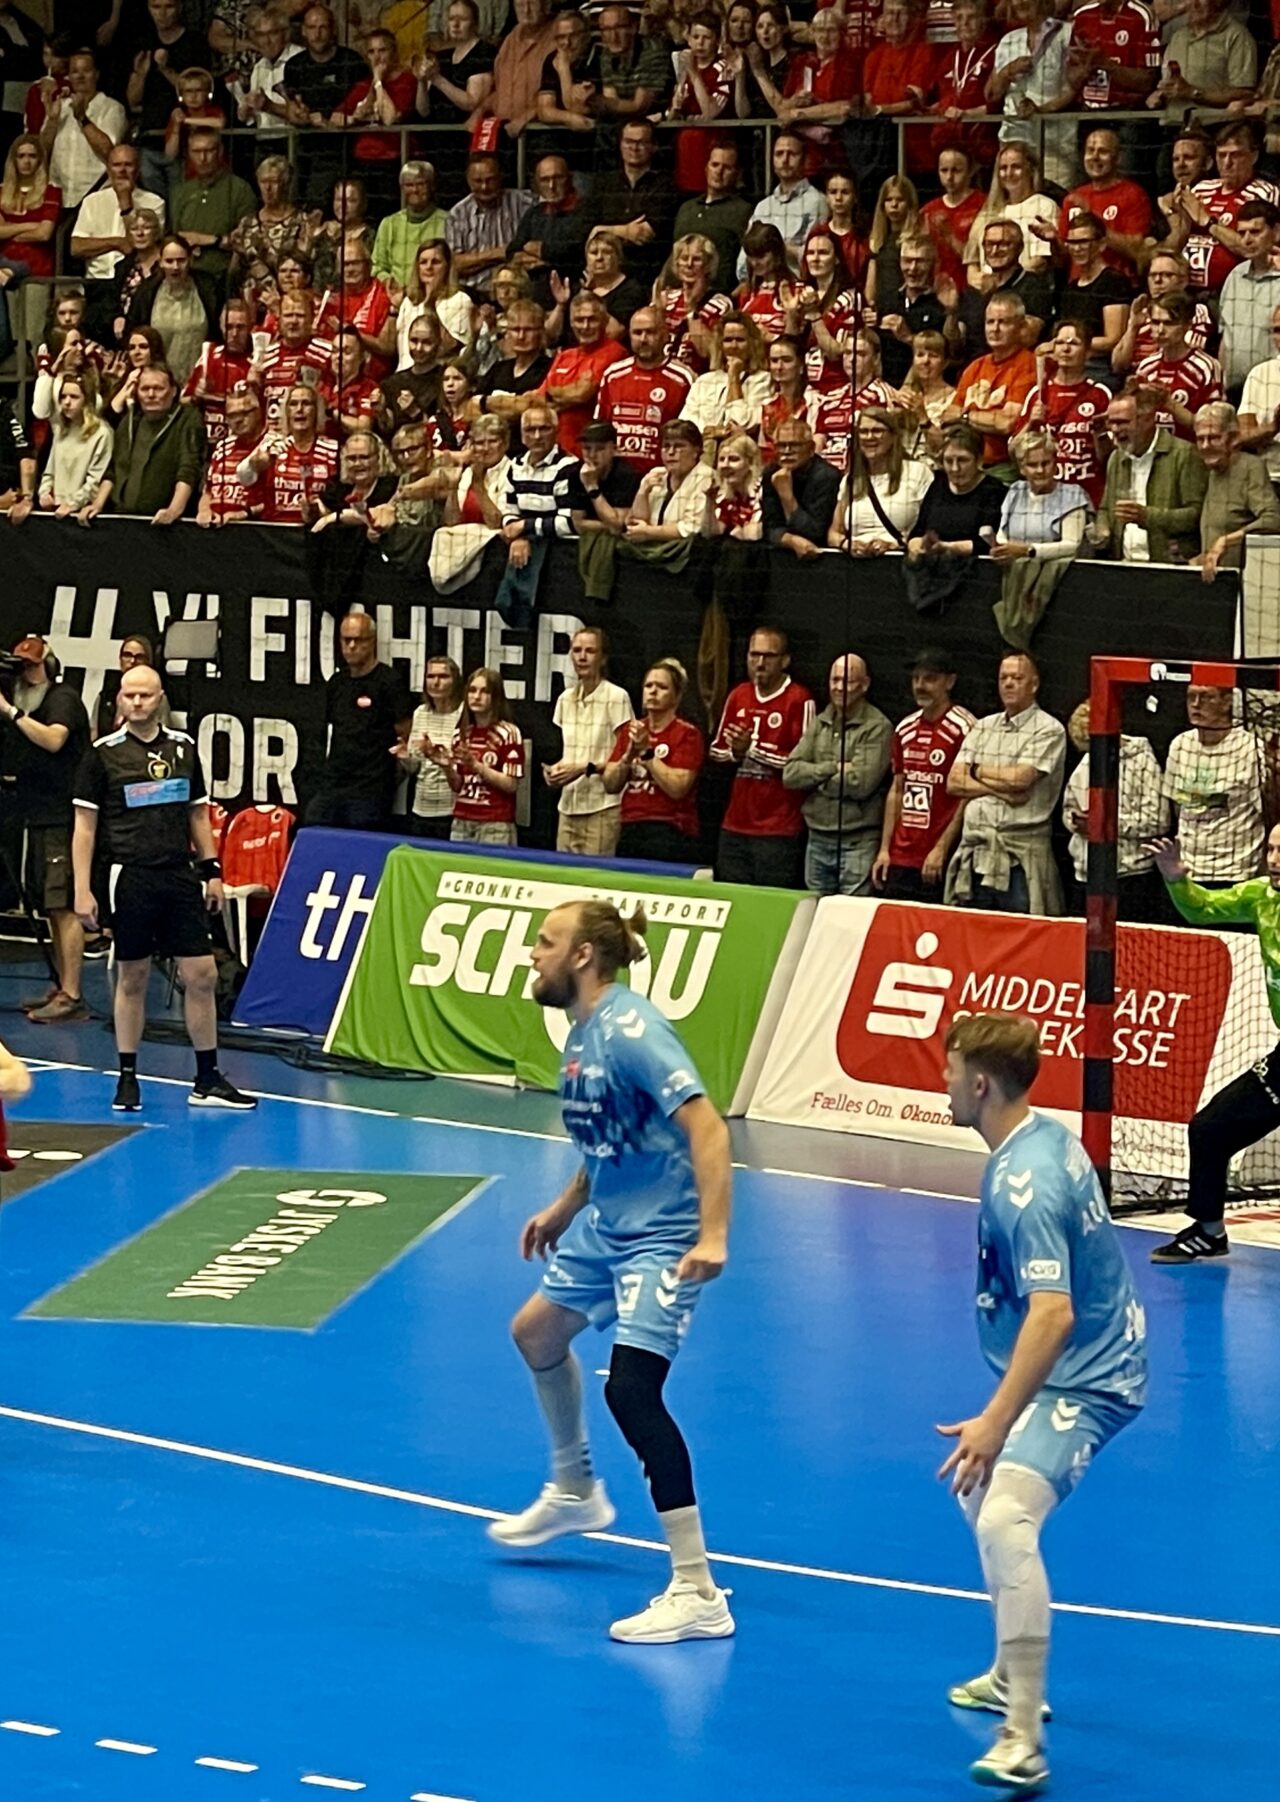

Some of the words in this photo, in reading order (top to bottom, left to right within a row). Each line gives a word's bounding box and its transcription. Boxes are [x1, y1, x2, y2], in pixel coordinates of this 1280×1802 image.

[811, 1091, 864, 1115] Fælles
[229, 1208, 339, 1255] JYSKE
[166, 1253, 283, 1300] BANK
